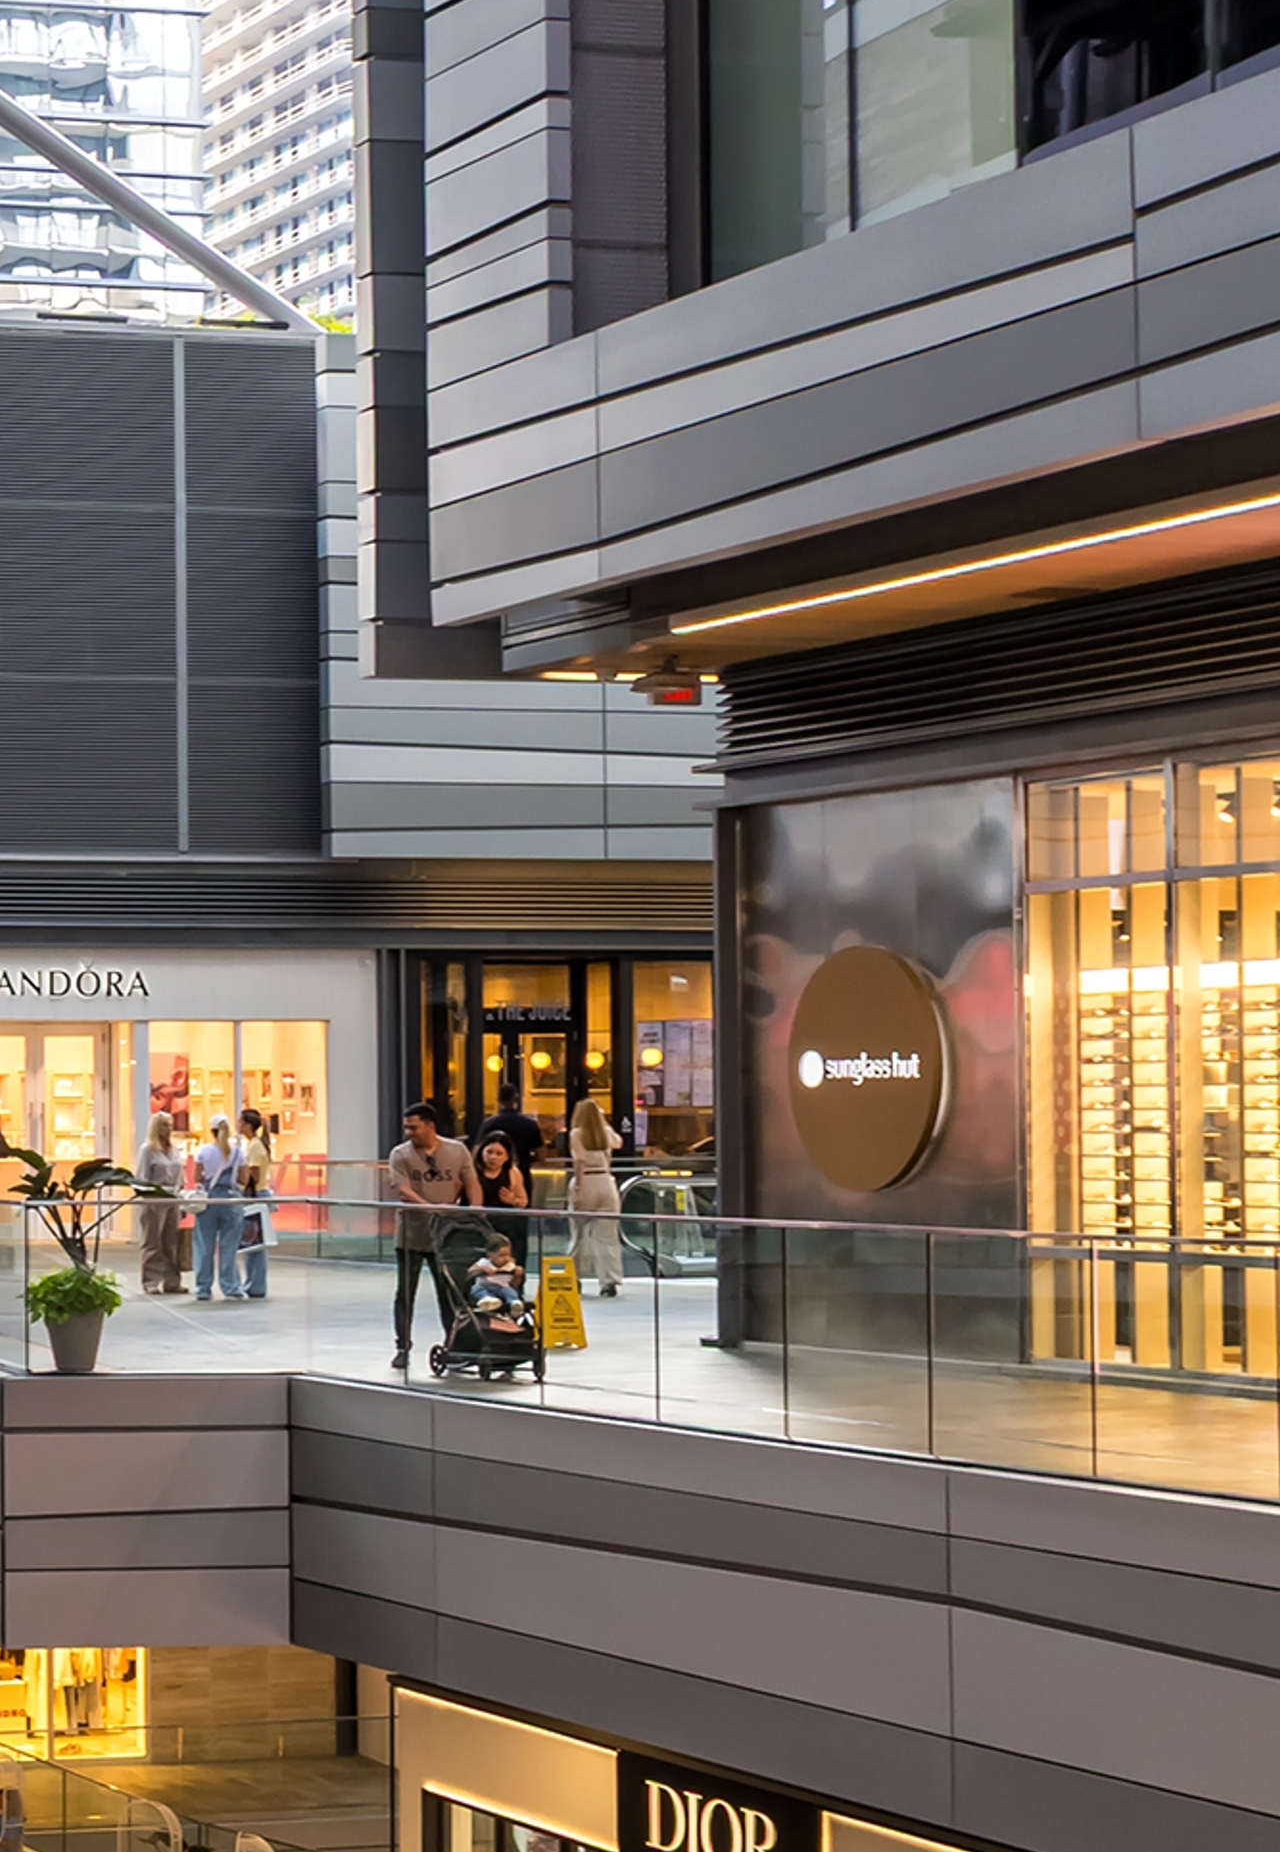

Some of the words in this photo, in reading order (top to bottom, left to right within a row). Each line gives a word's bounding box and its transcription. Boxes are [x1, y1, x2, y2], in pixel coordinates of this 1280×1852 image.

[825, 1051, 891, 1086] sunglass
[892, 1051, 921, 1079] hut
[411, 1168, 453, 1183] BOSS
